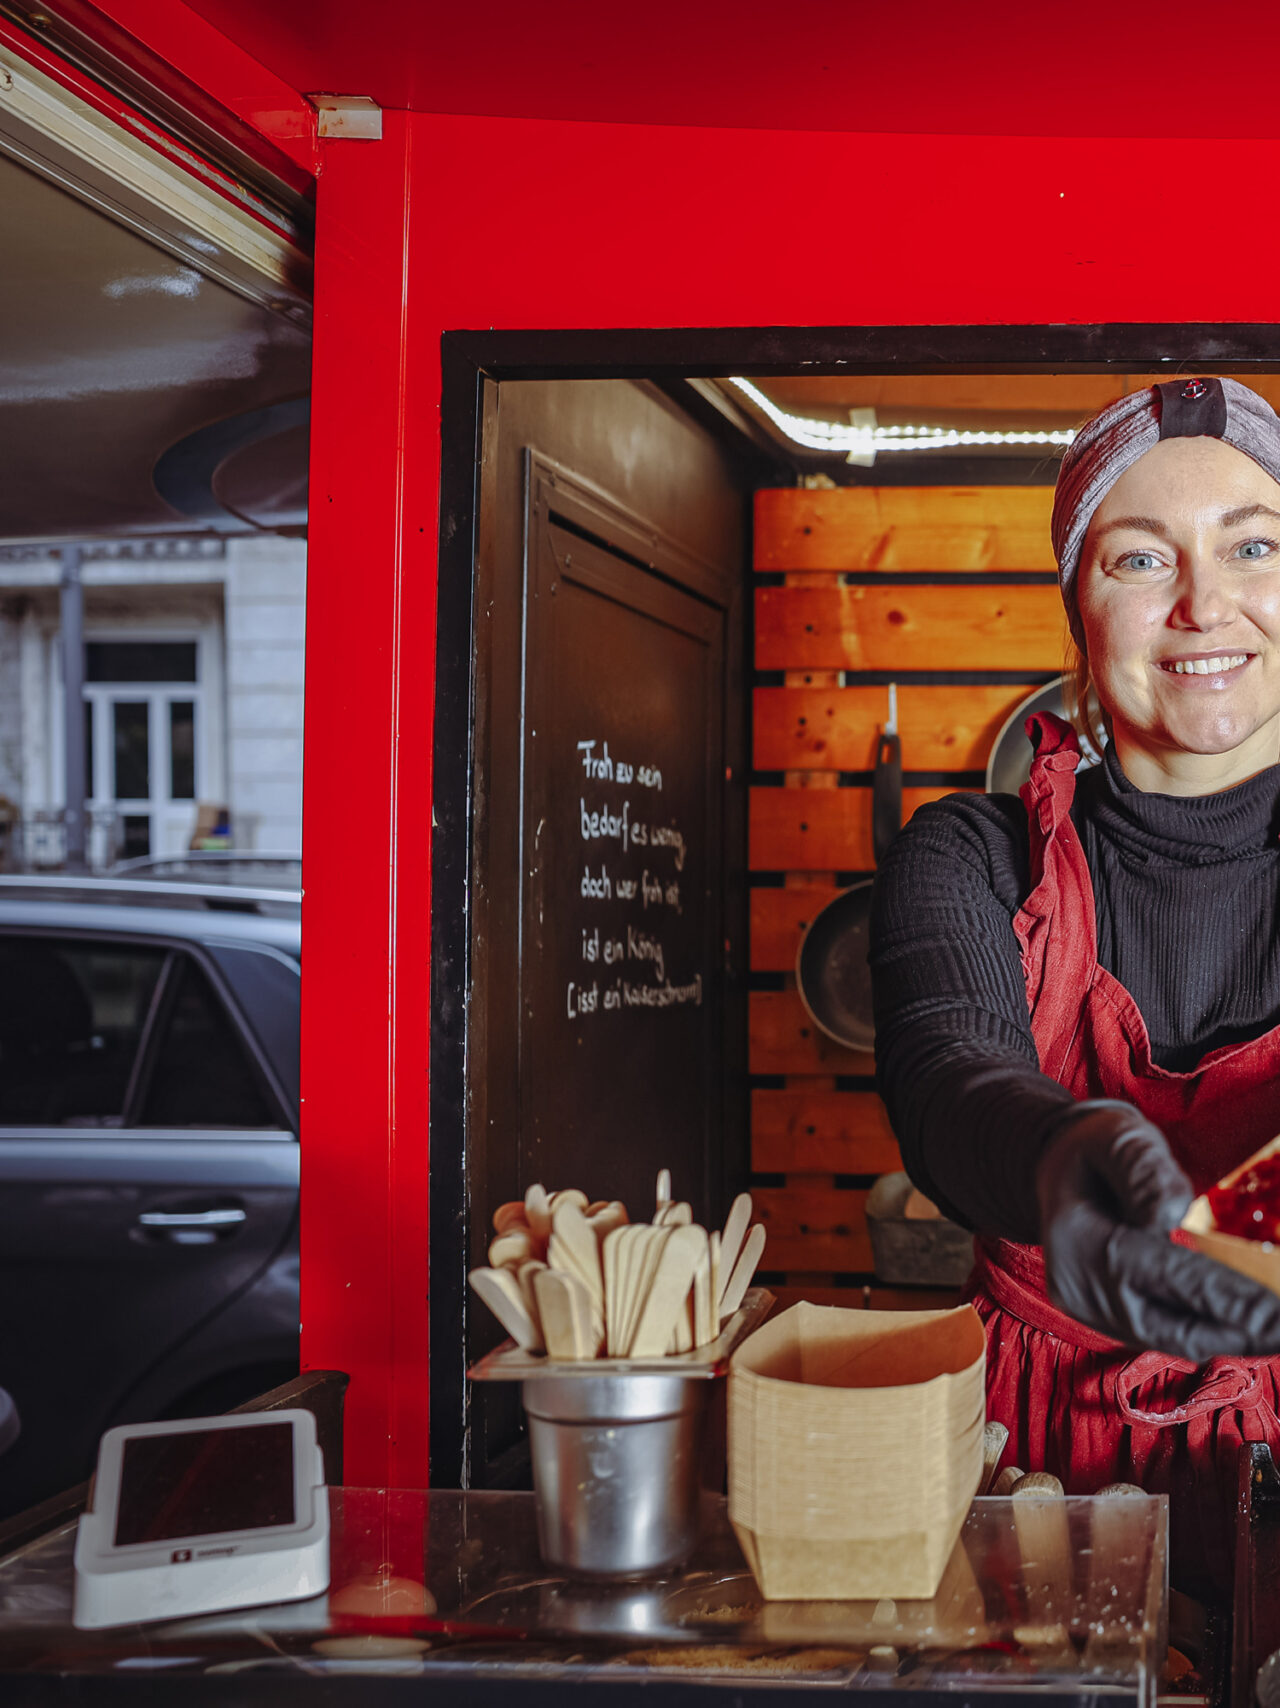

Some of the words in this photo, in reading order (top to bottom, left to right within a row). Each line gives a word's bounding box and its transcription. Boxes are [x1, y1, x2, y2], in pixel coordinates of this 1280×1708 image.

[577, 740, 614, 781] Froh
[616, 761, 634, 784] zu
[637, 764, 662, 792] sein
[580, 797, 630, 853] bedarf
[631, 821, 649, 846] es
[581, 864, 612, 899] doch
[616, 879, 638, 900] wer
[642, 869, 663, 910] froh
[582, 928, 599, 963] ist
[603, 937, 625, 966] ein
[627, 925, 665, 983] König
